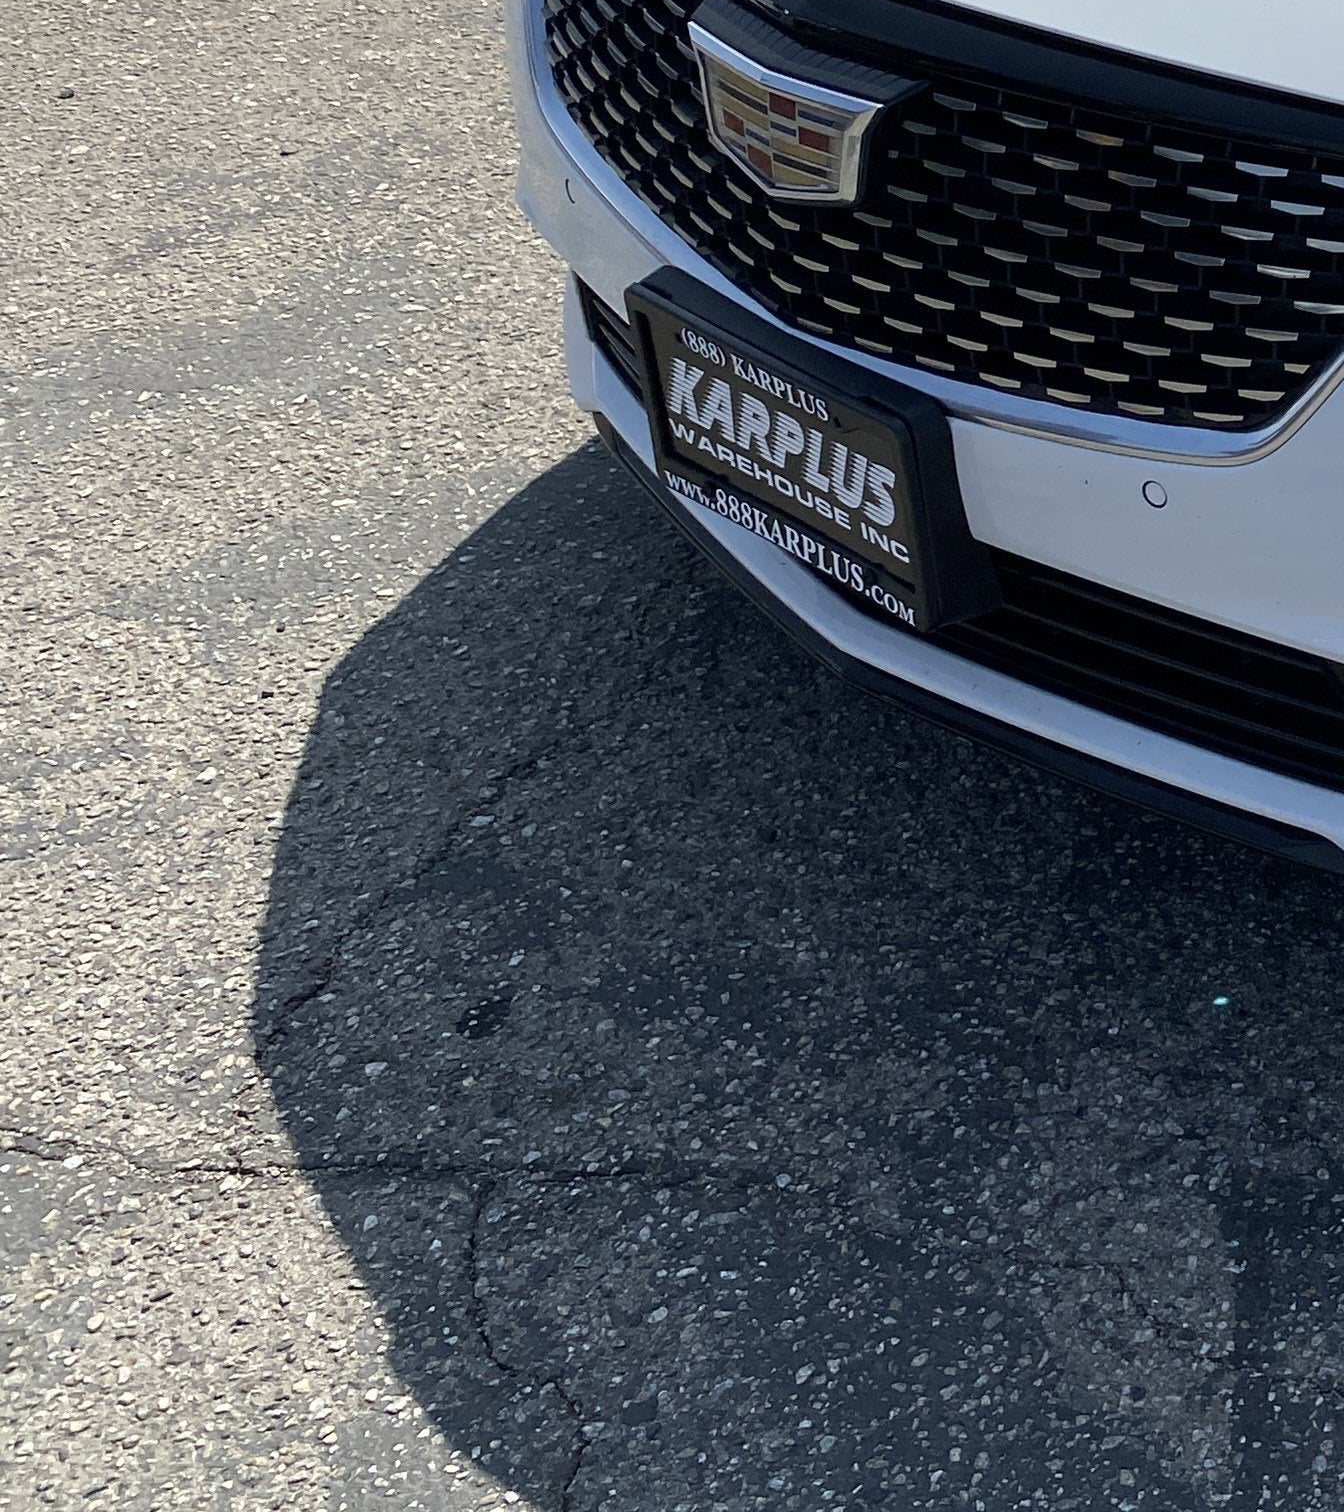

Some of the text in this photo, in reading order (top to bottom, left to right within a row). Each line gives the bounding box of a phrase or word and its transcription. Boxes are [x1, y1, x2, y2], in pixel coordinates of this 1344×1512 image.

[666, 356, 897, 527] KARPLUS
[681, 327, 830, 422] (888) KARPLUS
[667, 418, 910, 564] WAREHOUSE INC
